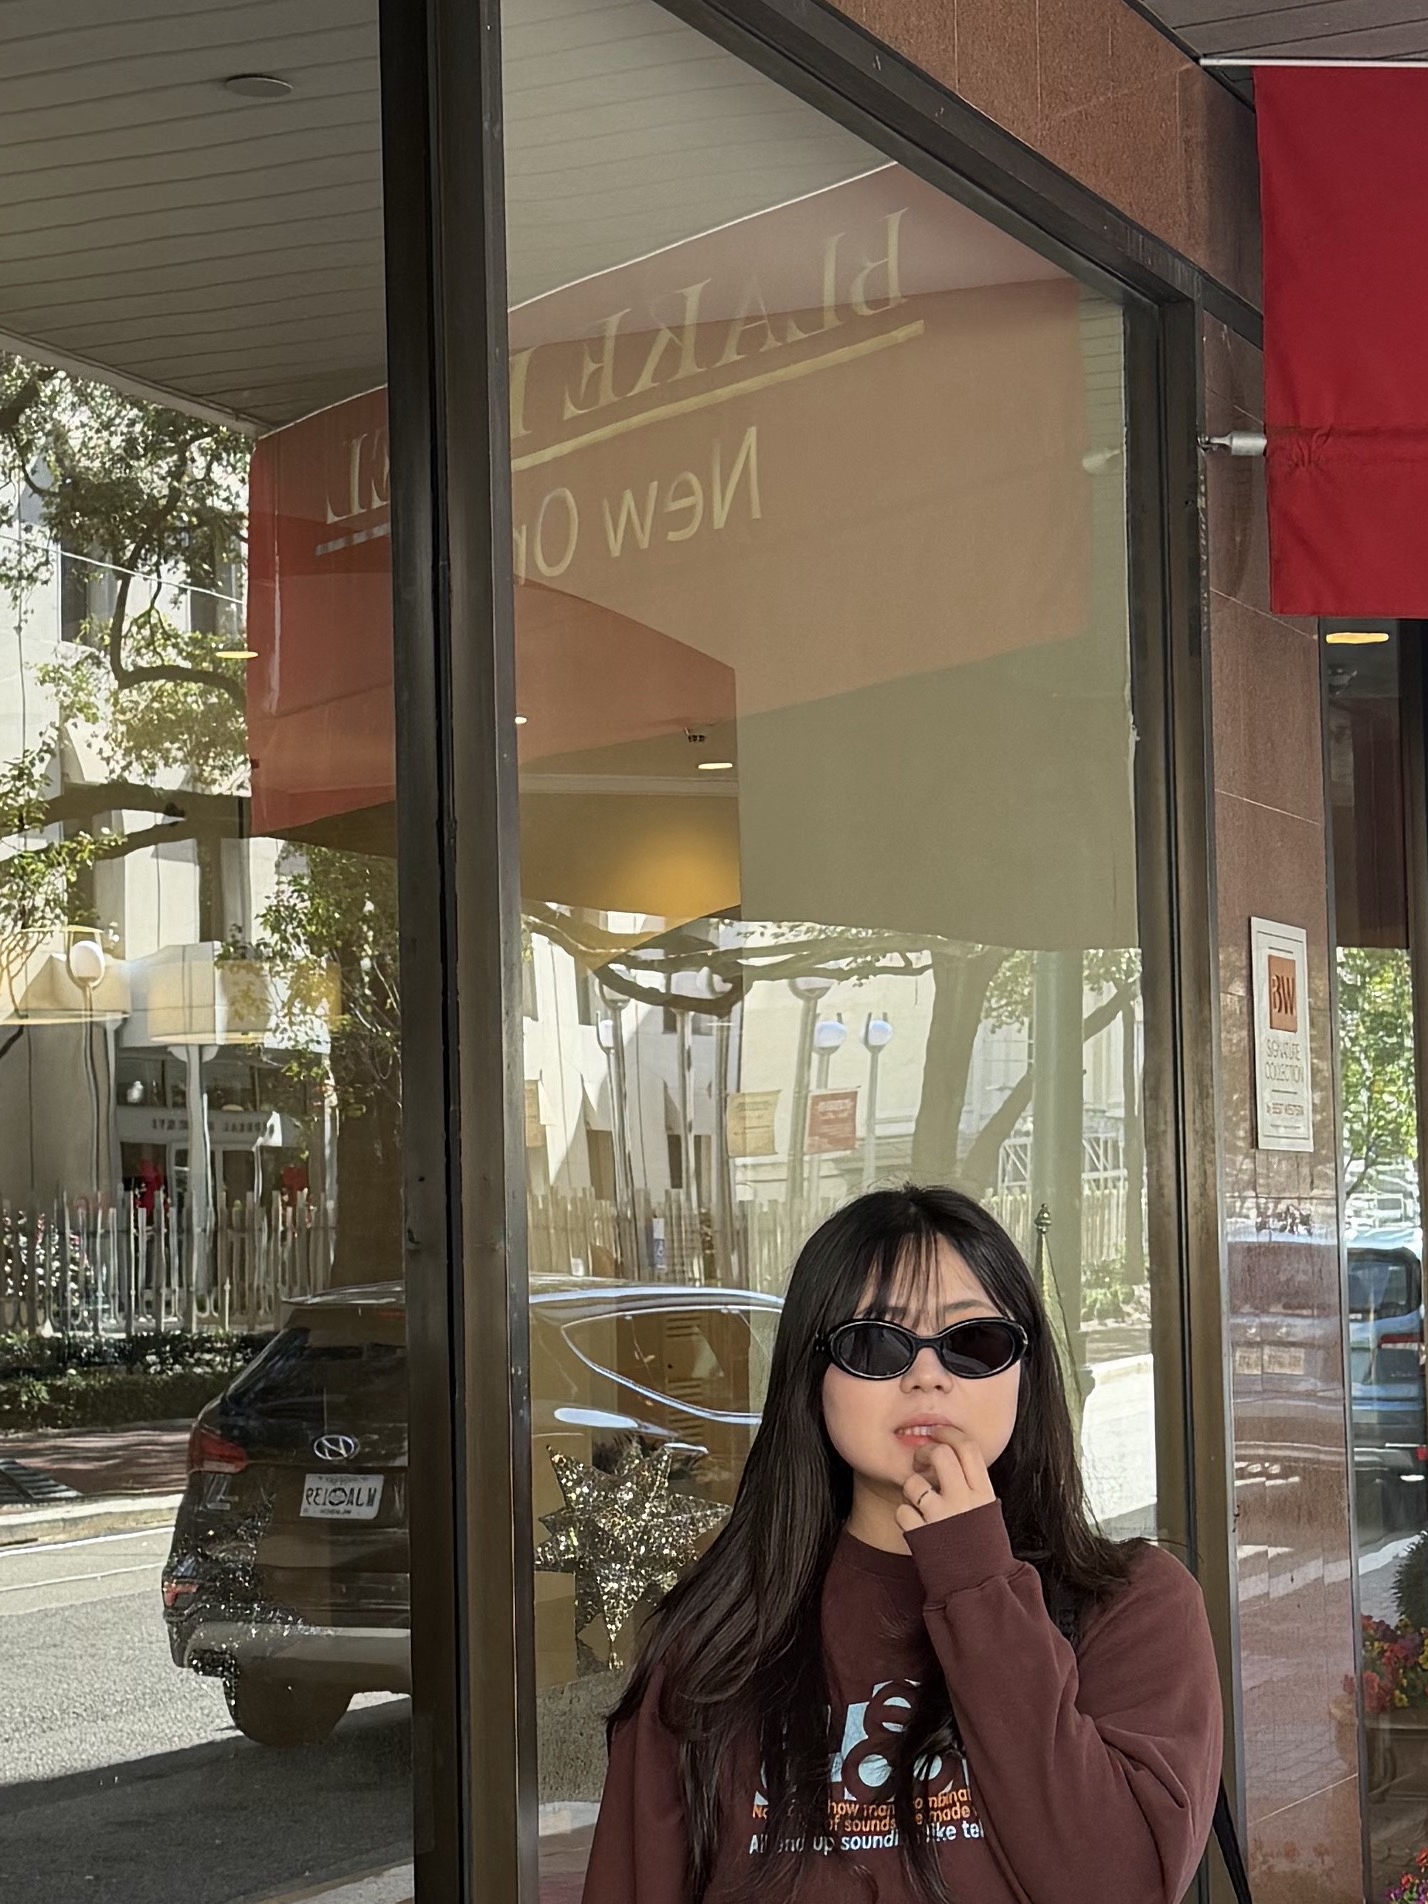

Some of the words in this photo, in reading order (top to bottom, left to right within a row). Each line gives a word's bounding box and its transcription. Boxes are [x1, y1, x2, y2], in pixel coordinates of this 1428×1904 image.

[863, 1802, 896, 1816] man
[844, 1816, 897, 1832] sounds
[812, 1835, 835, 1856] up
